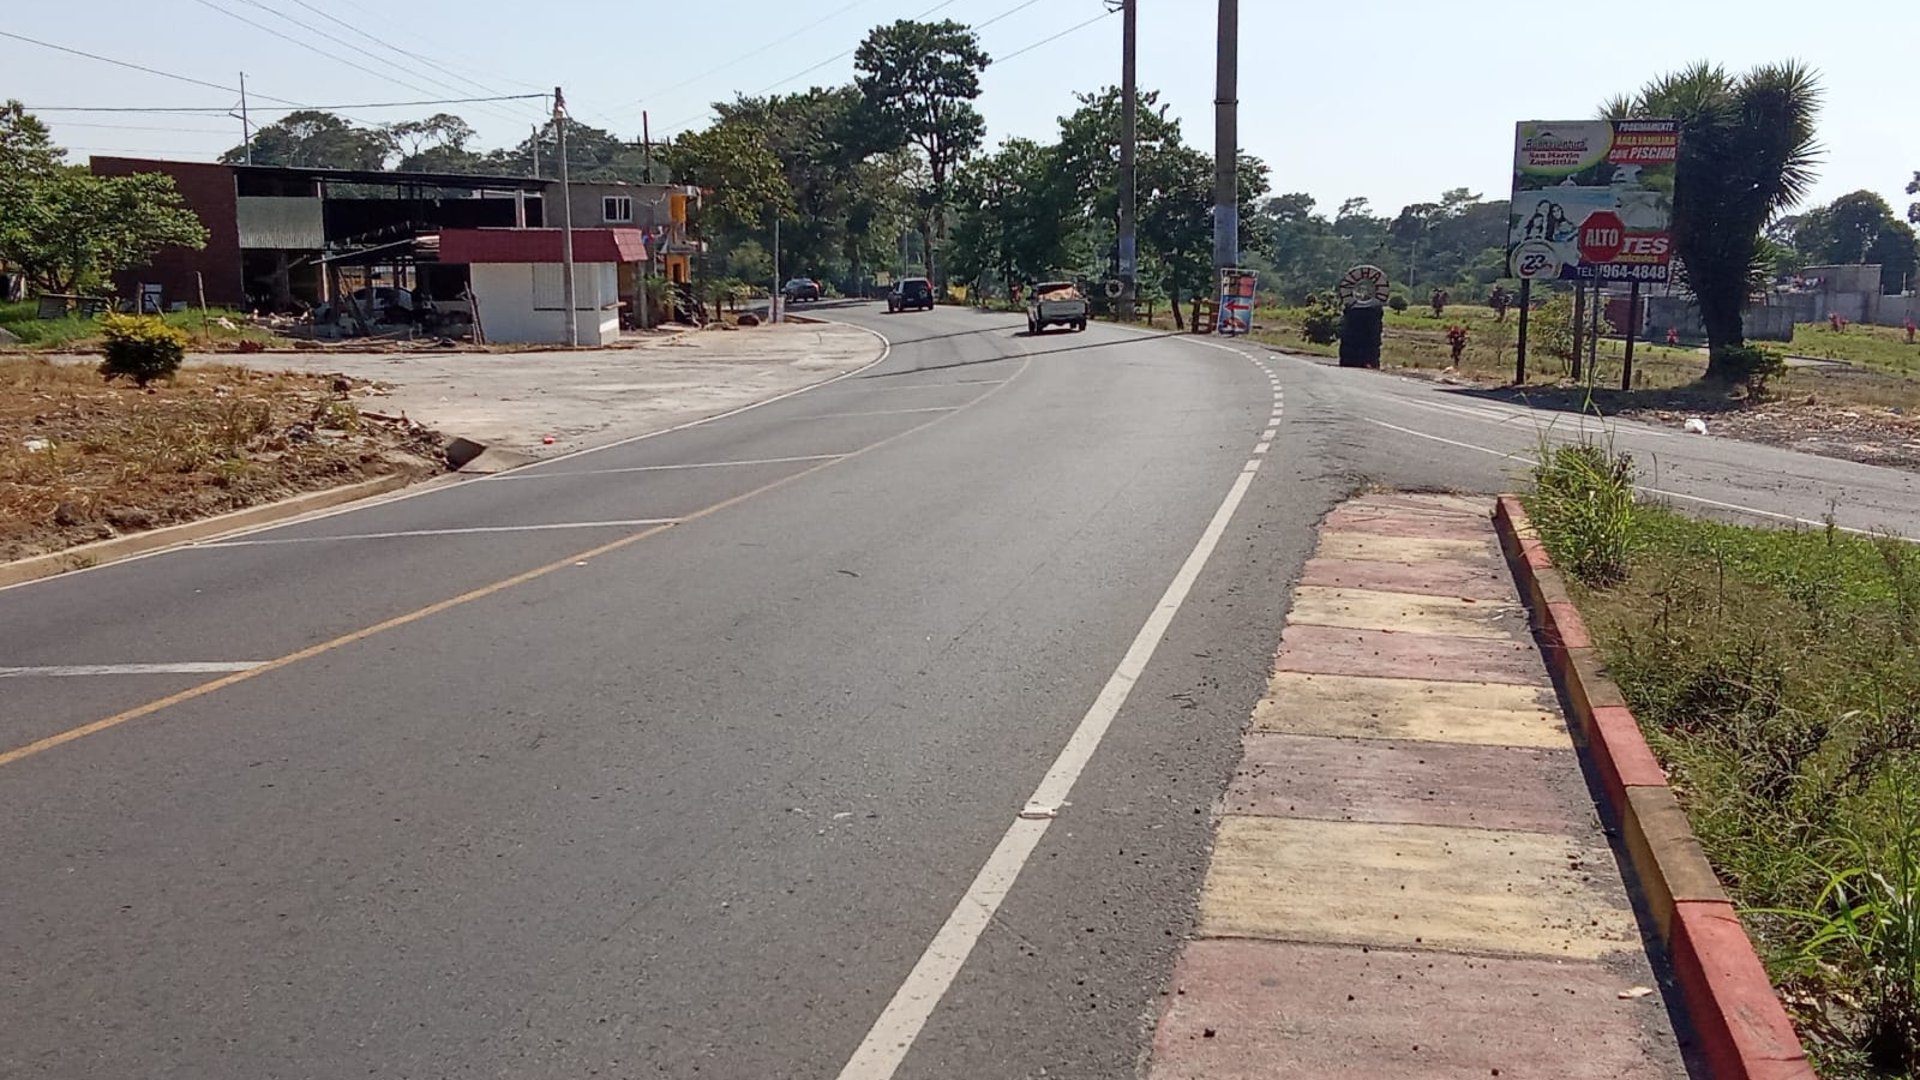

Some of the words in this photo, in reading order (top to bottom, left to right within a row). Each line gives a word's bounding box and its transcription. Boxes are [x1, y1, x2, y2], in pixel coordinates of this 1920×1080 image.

[1629, 146, 1676, 160] PISCINA
[1585, 228, 1619, 247] ALTO
[1621, 237, 1669, 254] TES
